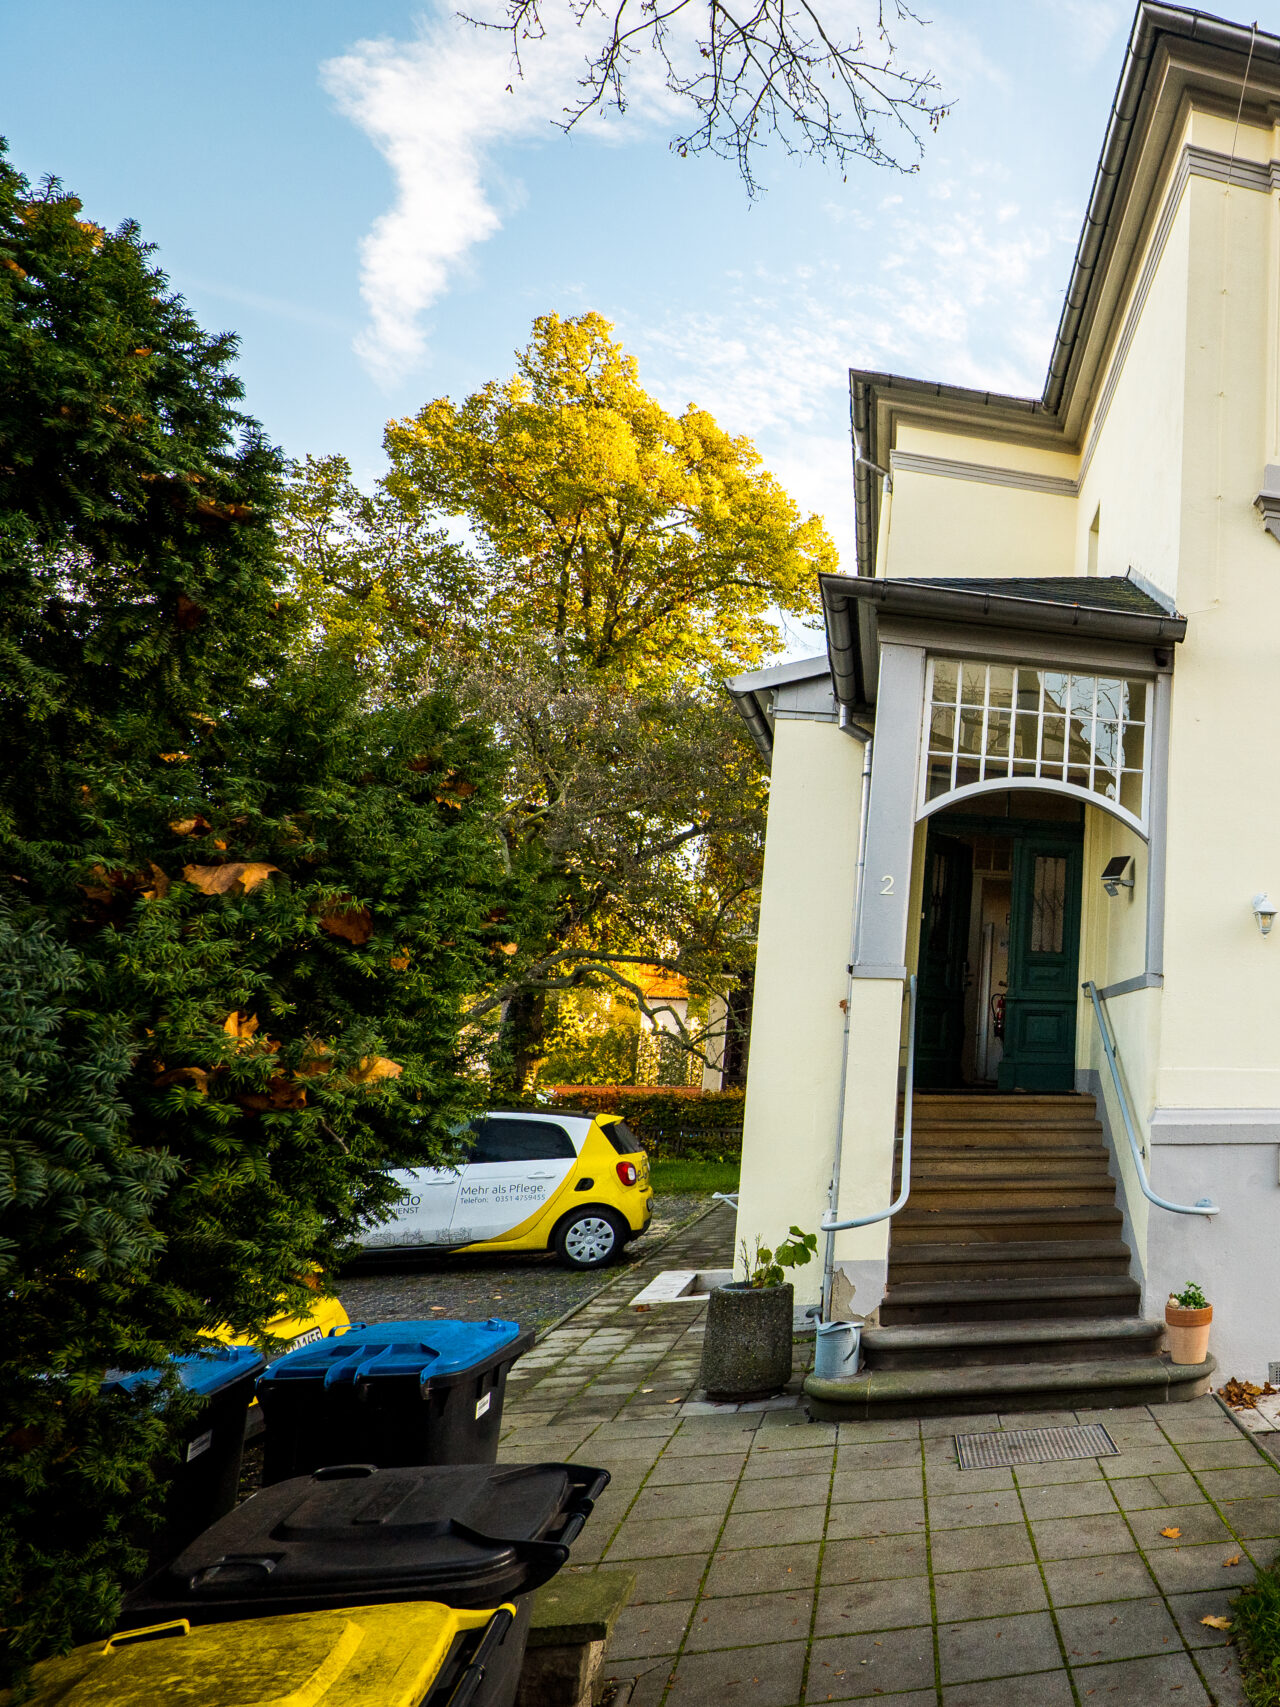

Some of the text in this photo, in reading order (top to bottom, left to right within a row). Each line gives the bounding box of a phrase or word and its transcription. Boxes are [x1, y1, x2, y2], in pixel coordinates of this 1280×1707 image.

[880, 875, 895, 896] 2
[461, 1183, 546, 1195] Mehr als Pflege.
